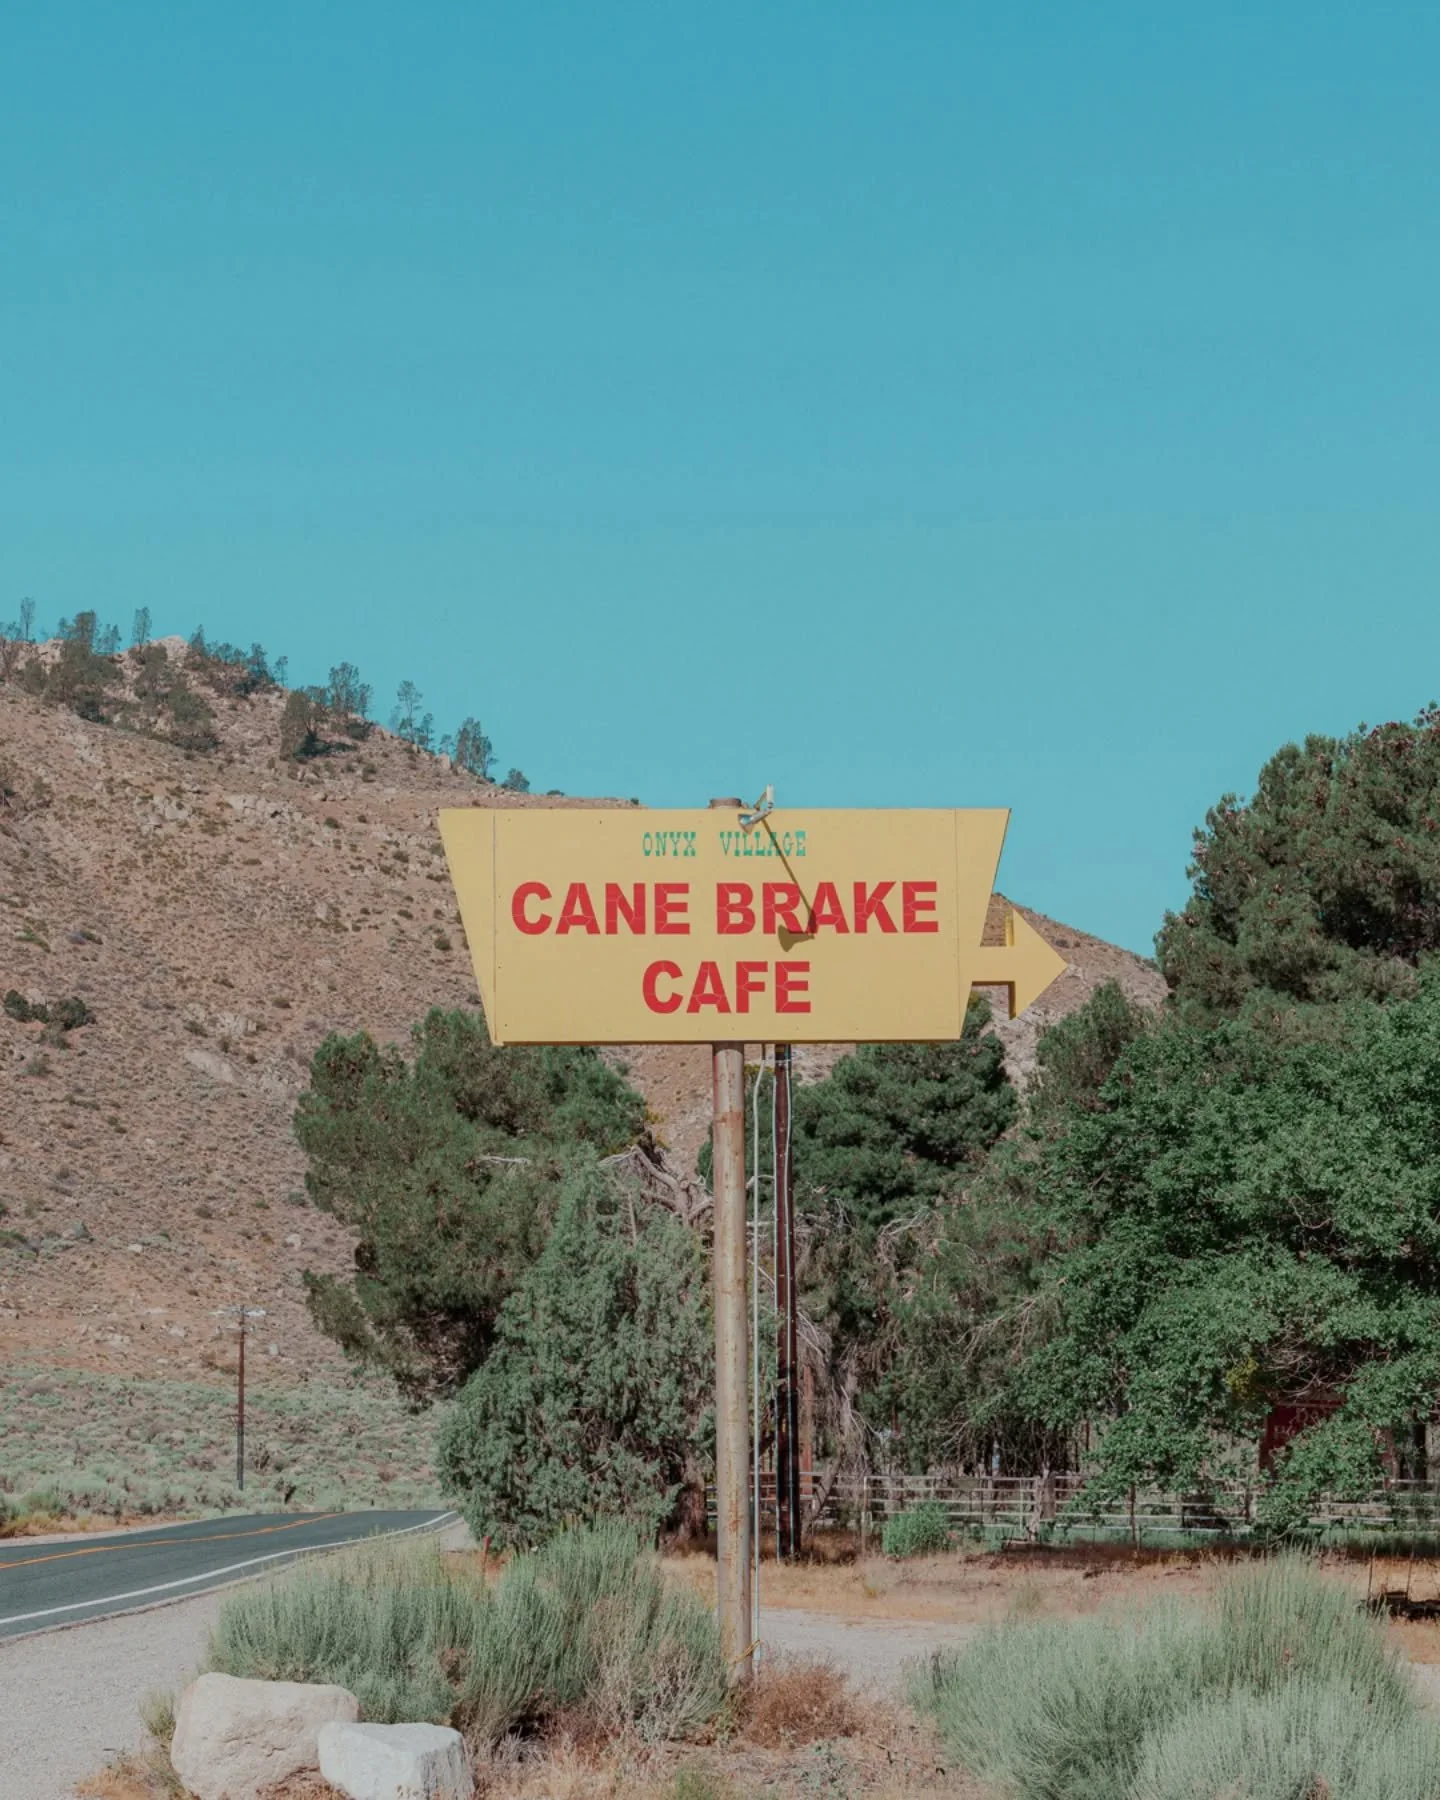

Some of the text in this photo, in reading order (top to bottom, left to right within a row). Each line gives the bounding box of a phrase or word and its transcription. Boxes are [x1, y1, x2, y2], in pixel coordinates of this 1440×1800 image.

[641, 830, 807, 857] ONYX VILLAGE
[512, 880, 938, 935] CANE BRAKE
[643, 961, 811, 1014] CAFE
